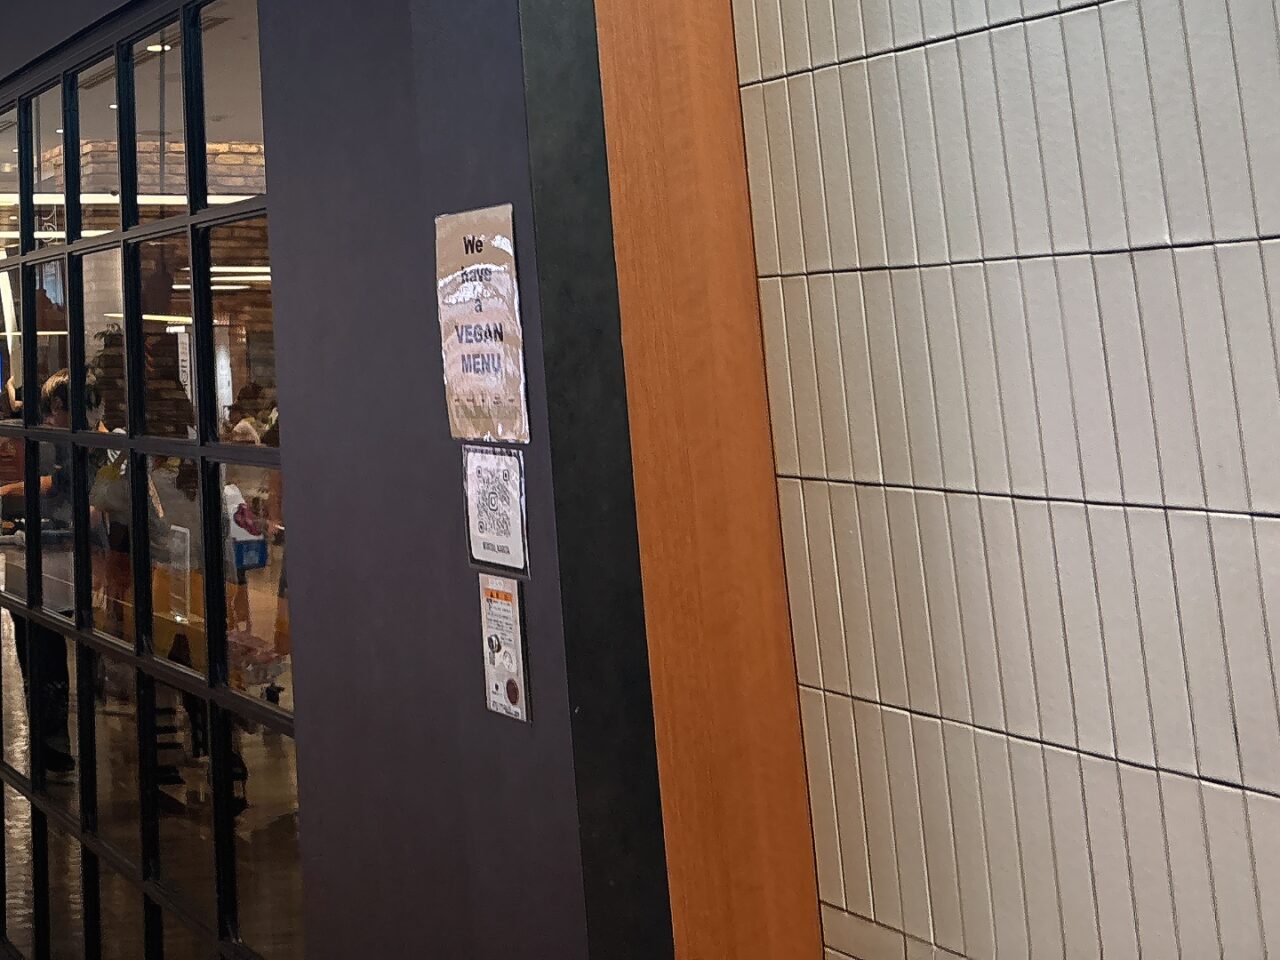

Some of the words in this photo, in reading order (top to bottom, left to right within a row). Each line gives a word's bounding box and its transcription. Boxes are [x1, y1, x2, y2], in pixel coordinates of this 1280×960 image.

[463, 235, 483, 254] We
[461, 266, 492, 283] have
[475, 298, 482, 312] a
[455, 323, 503, 343] VEGAN
[461, 353, 501, 374] MENU
